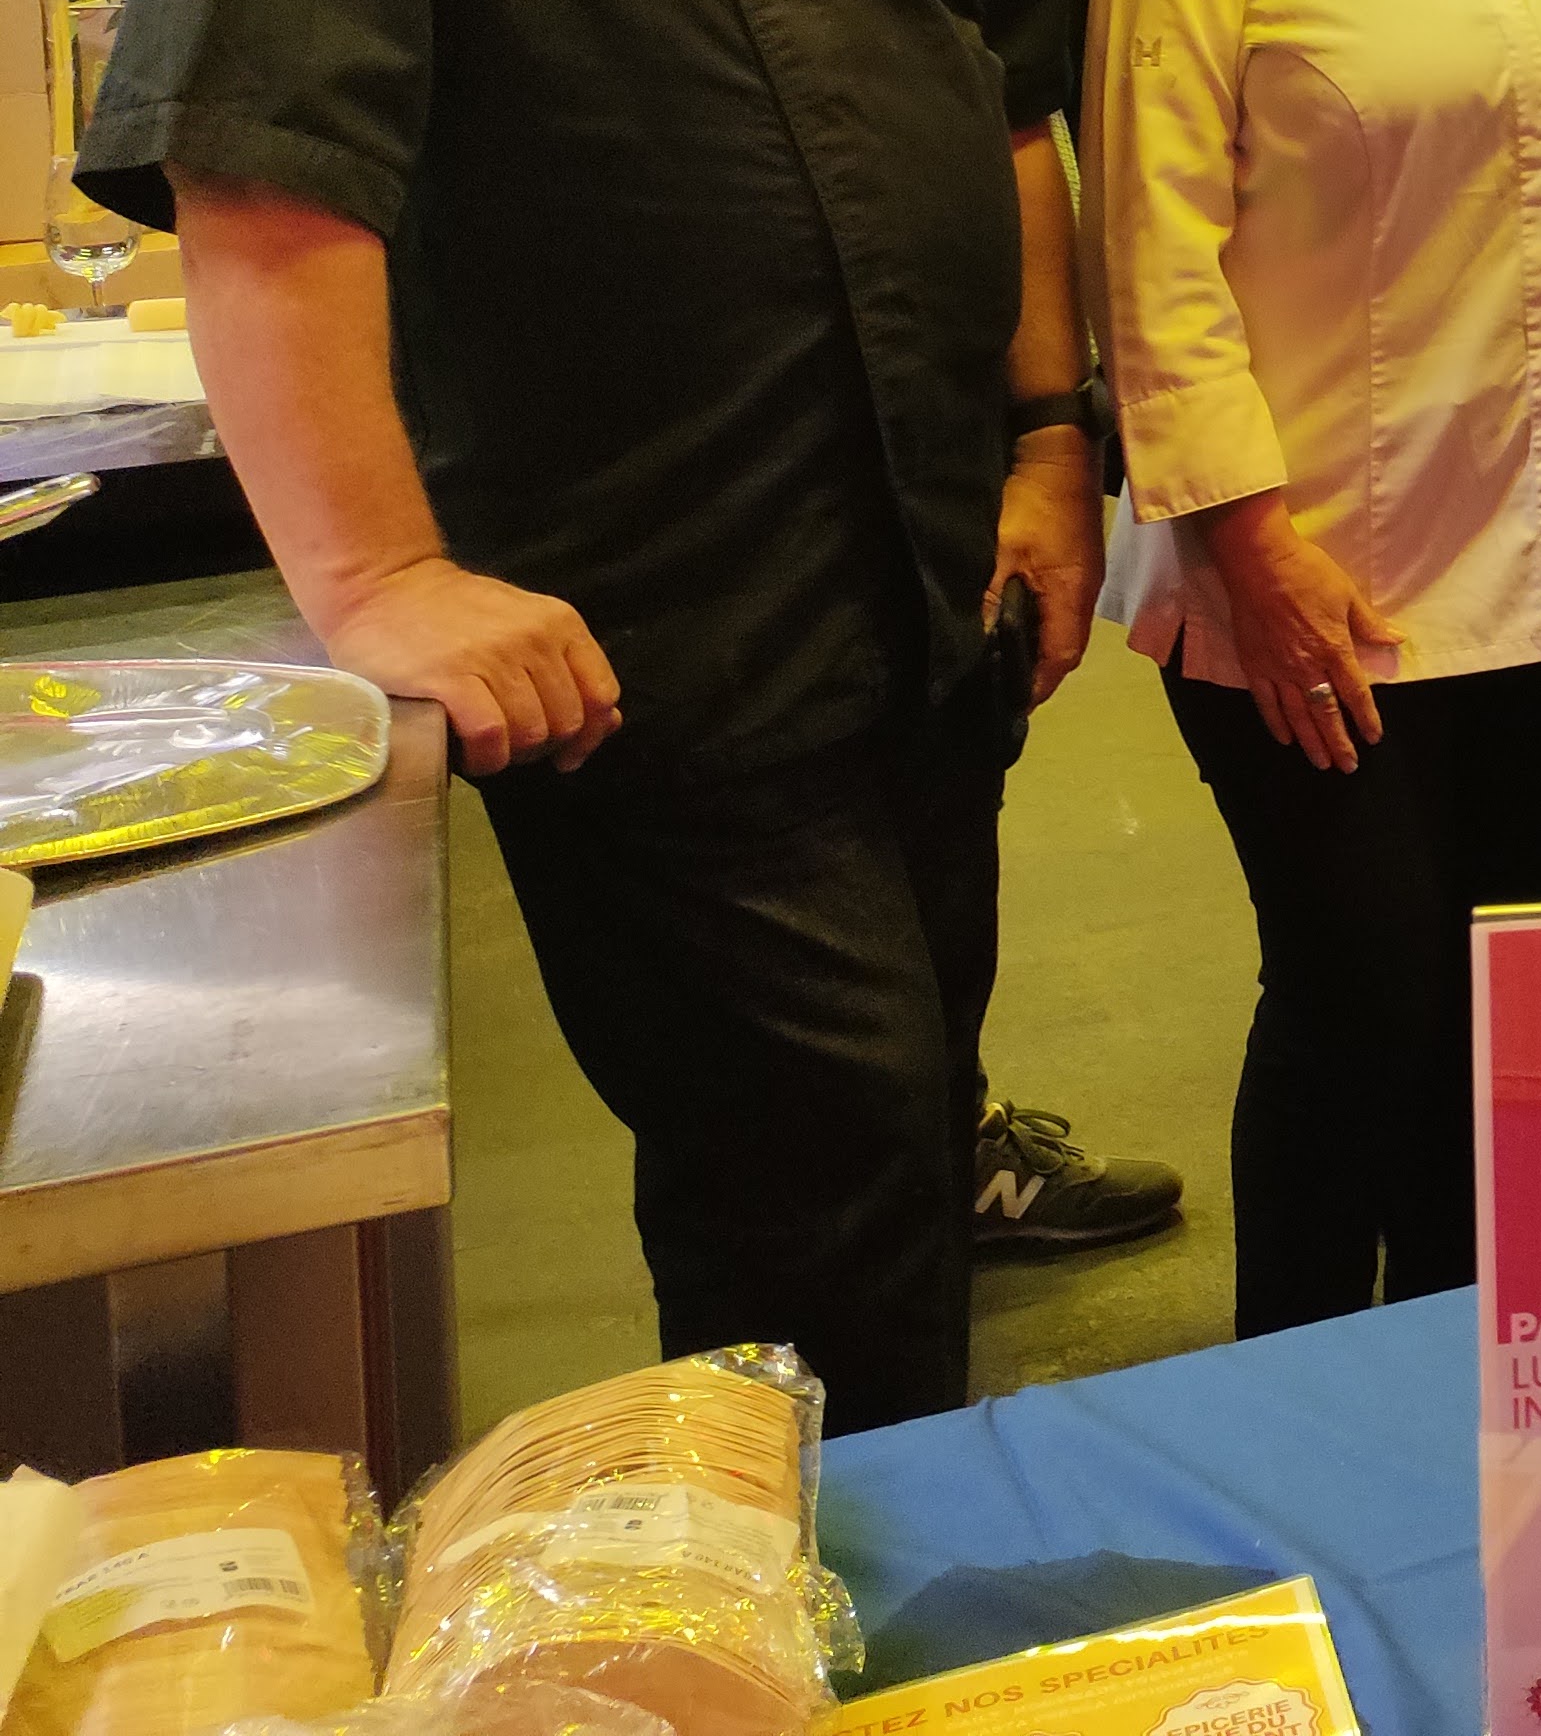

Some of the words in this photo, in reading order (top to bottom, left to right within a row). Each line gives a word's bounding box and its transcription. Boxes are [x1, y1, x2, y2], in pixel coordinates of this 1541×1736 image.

[943, 1684, 1024, 1718] NOS
[1040, 1627, 1270, 1694] SPECIALITES
[1166, 1699, 1292, 1736] EPICERIE
[1248, 1715, 1286, 1735] DU
